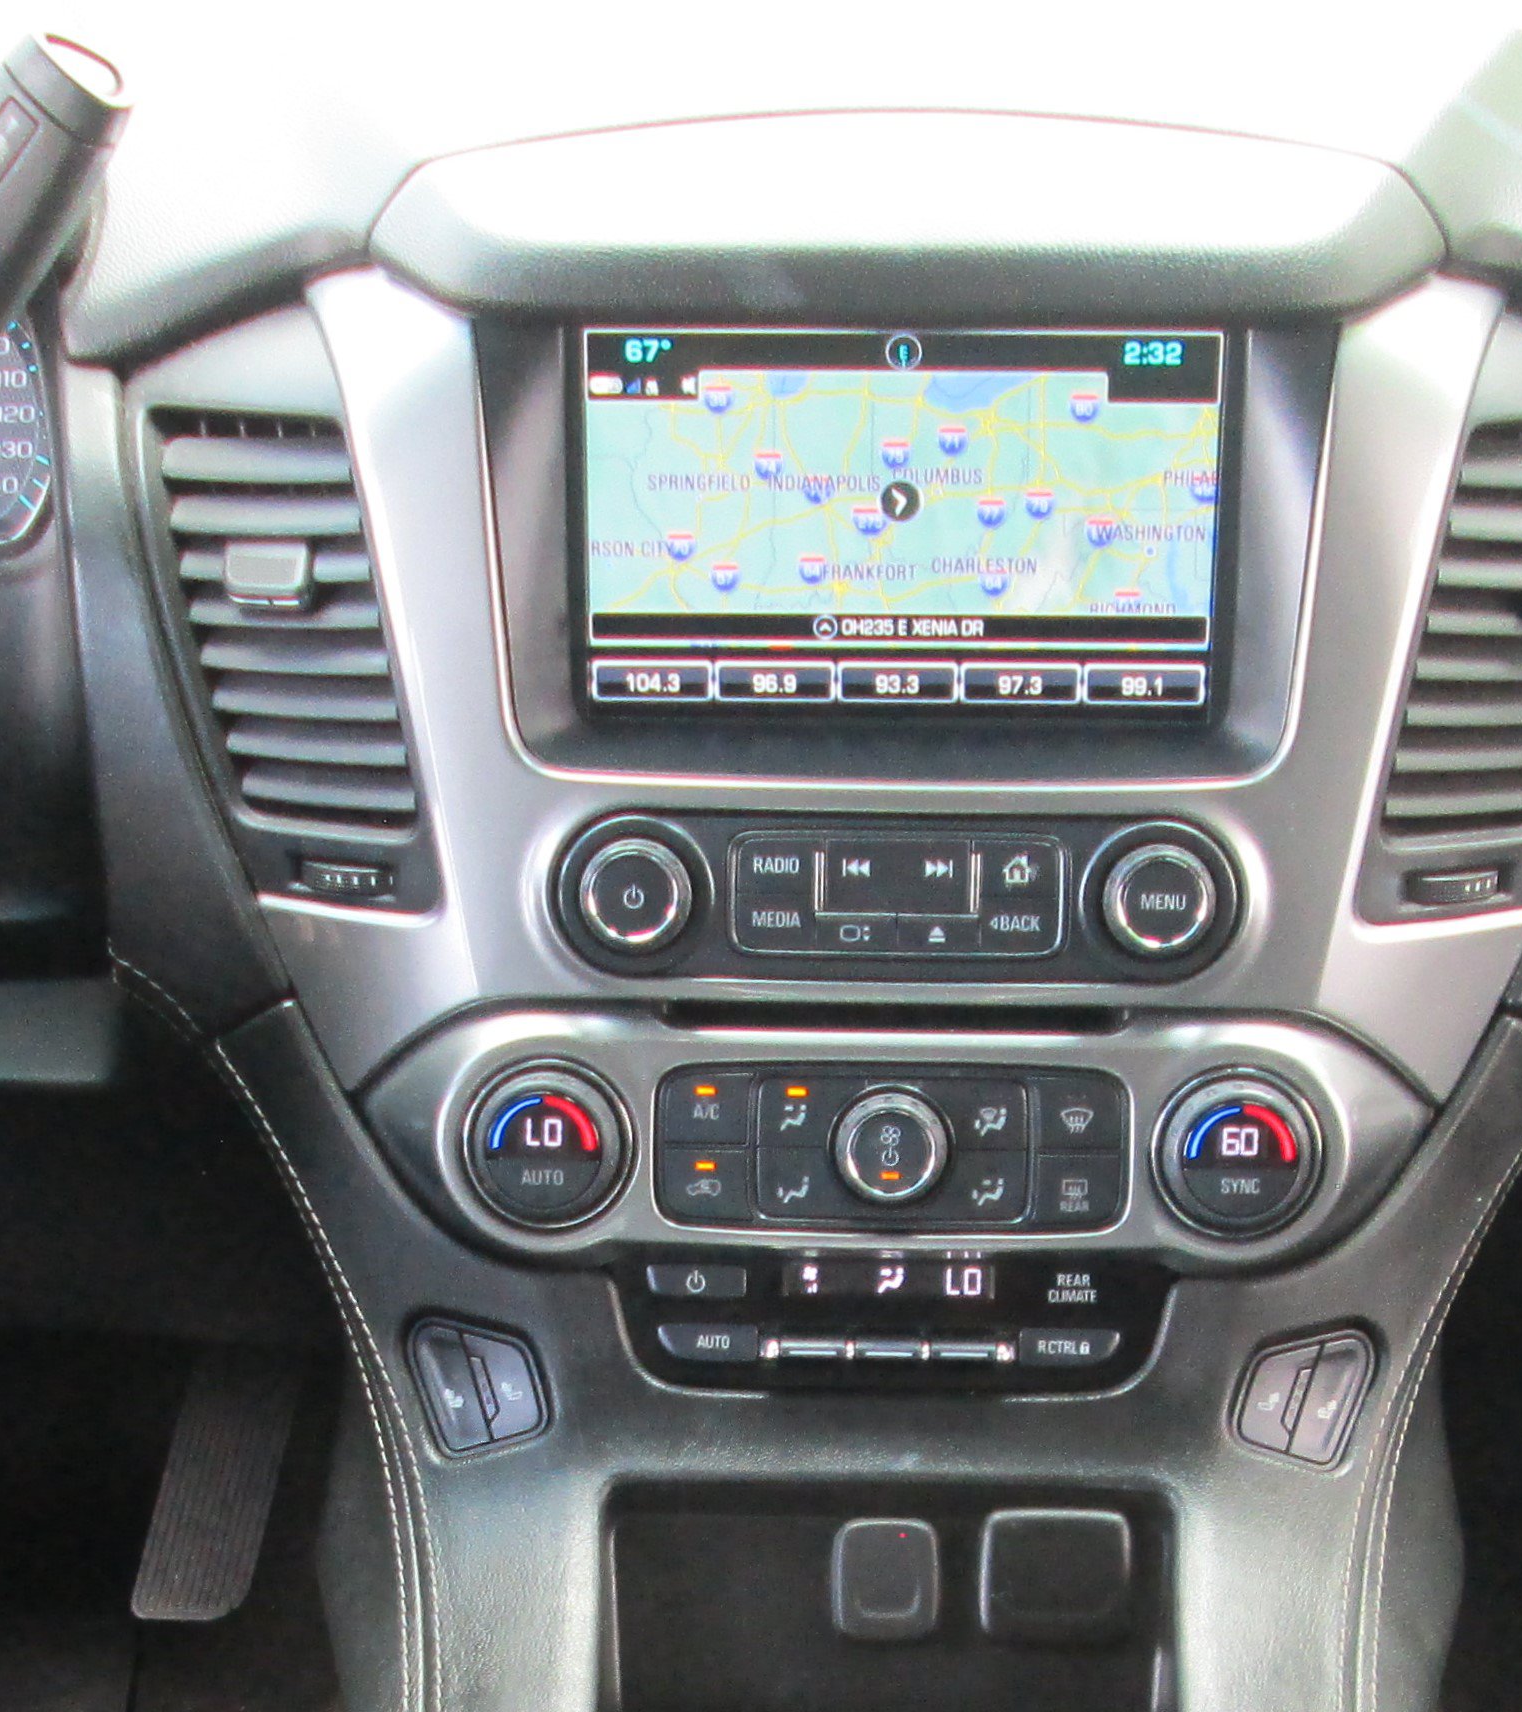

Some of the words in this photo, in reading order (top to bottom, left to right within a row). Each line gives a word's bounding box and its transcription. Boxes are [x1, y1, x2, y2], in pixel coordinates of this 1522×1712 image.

[1123, 340, 1185, 366] 2:32
[647, 474, 751, 491] SPRINGFIELD
[767, 475, 881, 492] INDIANAPOLIS
[891, 468, 983, 486] COLUMBUS
[1096, 525, 1206, 542] WASHINGTON
[821, 563, 917, 581] FRANKFORT
[931, 557, 1038, 574] CHARLESTON
[897, 618, 909, 636] E
[912, 618, 958, 637] XENIA
[961, 618, 985, 637] DR
[626, 673, 681, 693] 104.3
[752, 674, 797, 694] 96.9
[874, 674, 921, 695] 93.3
[997, 675, 1044, 696] 97.3
[1120, 676, 1164, 697] 99.1
[752, 856, 800, 875] RADIO
[1140, 893, 1187, 911] MENU
[751, 910, 802, 929] MEDIA
[999, 914, 1041, 932] BACK
[693, 1103, 720, 1122] A/C
[524, 1118, 564, 1148] LO
[1220, 1127, 1259, 1157] 60
[520, 1169, 565, 1187] AUTO
[1220, 1178, 1260, 1195] SYNC
[1059, 1200, 1090, 1213] REAR
[944, 1267, 982, 1297] LO
[1056, 1273, 1091, 1288] REAR
[1047, 1288, 1098, 1304] CLIMATE
[695, 1334, 730, 1350] AUTO
